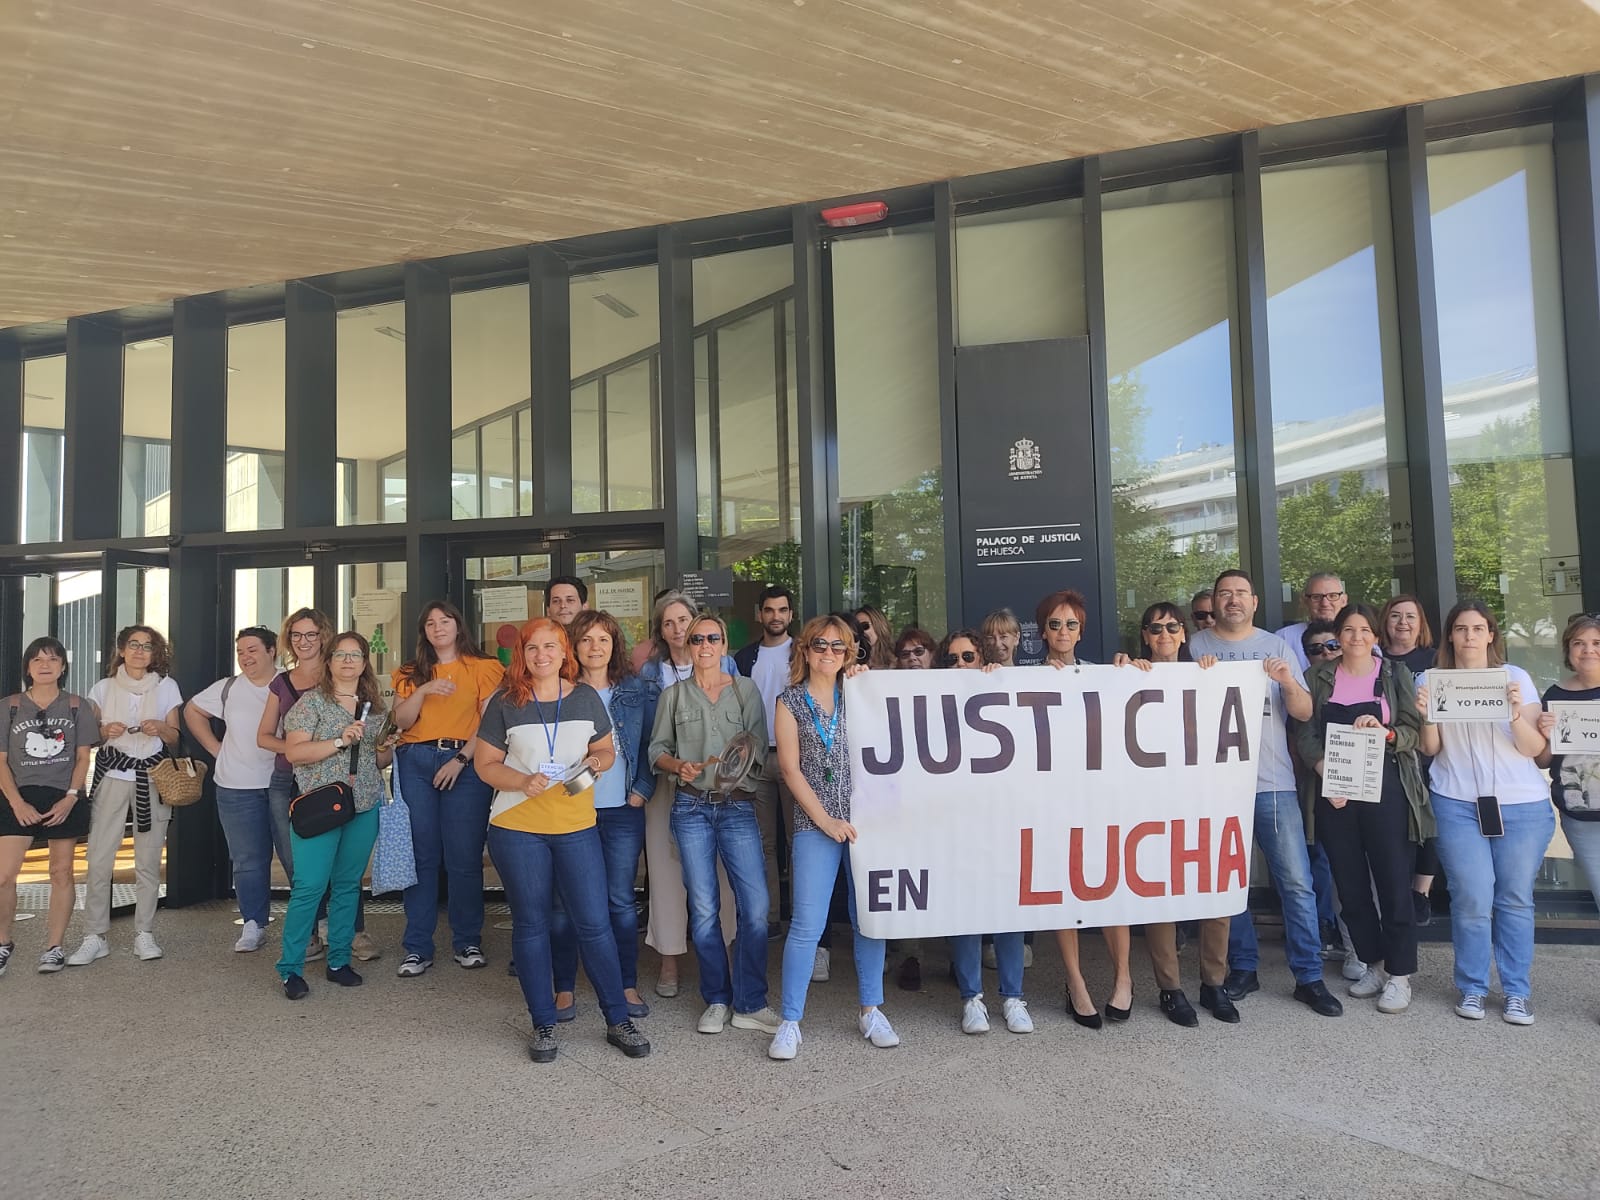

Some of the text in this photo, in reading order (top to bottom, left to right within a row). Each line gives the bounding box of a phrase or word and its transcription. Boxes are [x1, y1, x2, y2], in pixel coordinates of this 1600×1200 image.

[977, 533, 1081, 546] PALACIO DE JUSTICIA
[977, 546, 1025, 557] DE HUESCA
[1202, 651, 1272, 661] URLEY
[1474, 699, 1504, 707] PARO
[12, 718, 75, 735] HELLO KITTY
[861, 686, 1250, 775] JUSTICIA
[1582, 731, 1598, 739] YO
[869, 815, 1247, 912] EN LUCHA
